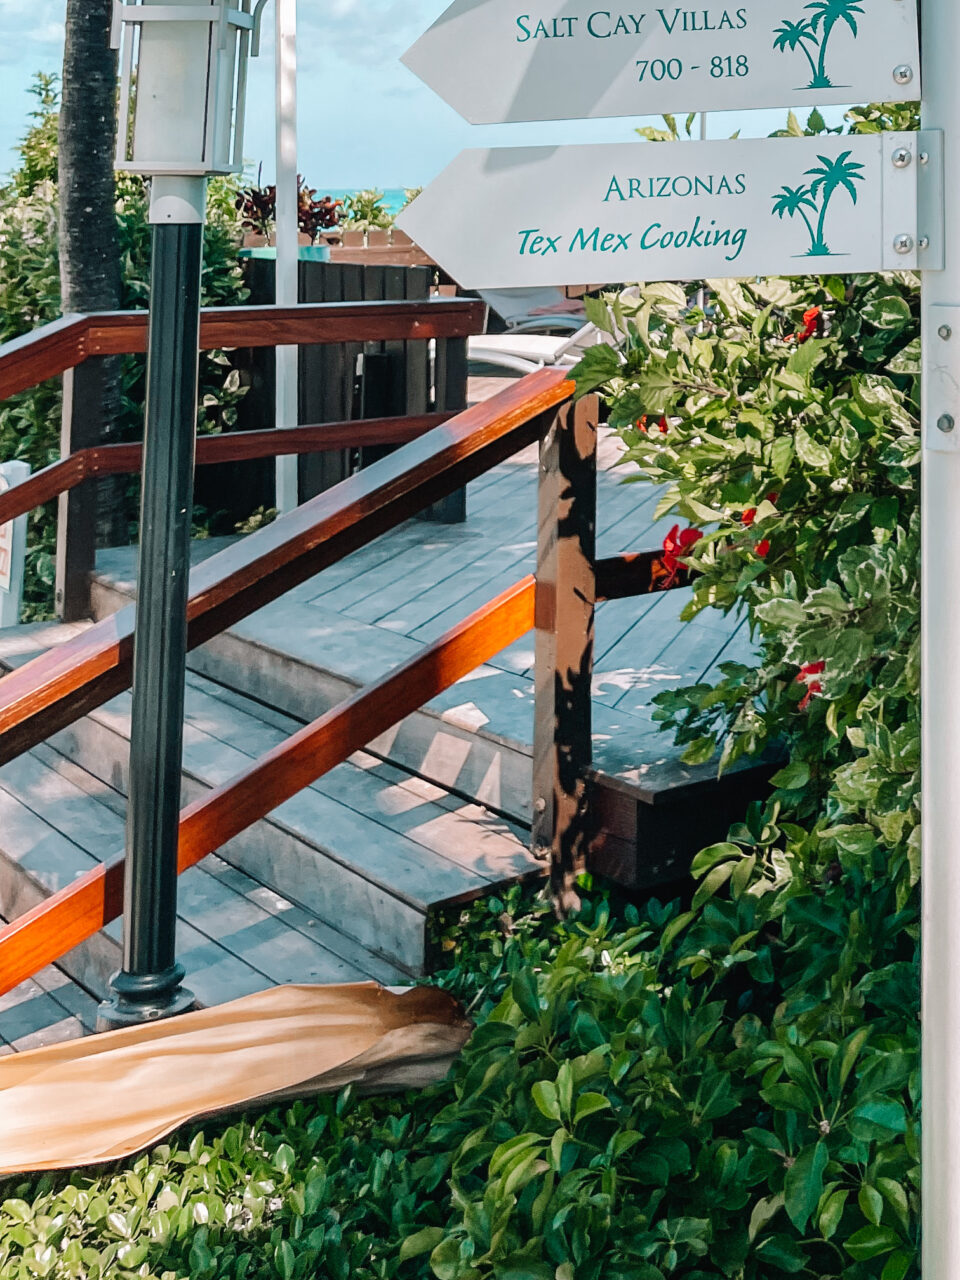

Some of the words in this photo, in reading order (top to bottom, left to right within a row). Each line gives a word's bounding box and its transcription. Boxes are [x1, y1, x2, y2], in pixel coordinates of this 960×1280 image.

[516, 14, 579, 43] SALT
[586, 11, 646, 39] CAY
[655, 8, 747, 35] VILLAS
[636, 58, 683, 82] 700
[709, 54, 749, 79] 818
[602, 173, 746, 202] ARIZONAS
[518, 228, 562, 256] Tex
[568, 226, 632, 253] Mex
[639, 215, 748, 261] Cooking
